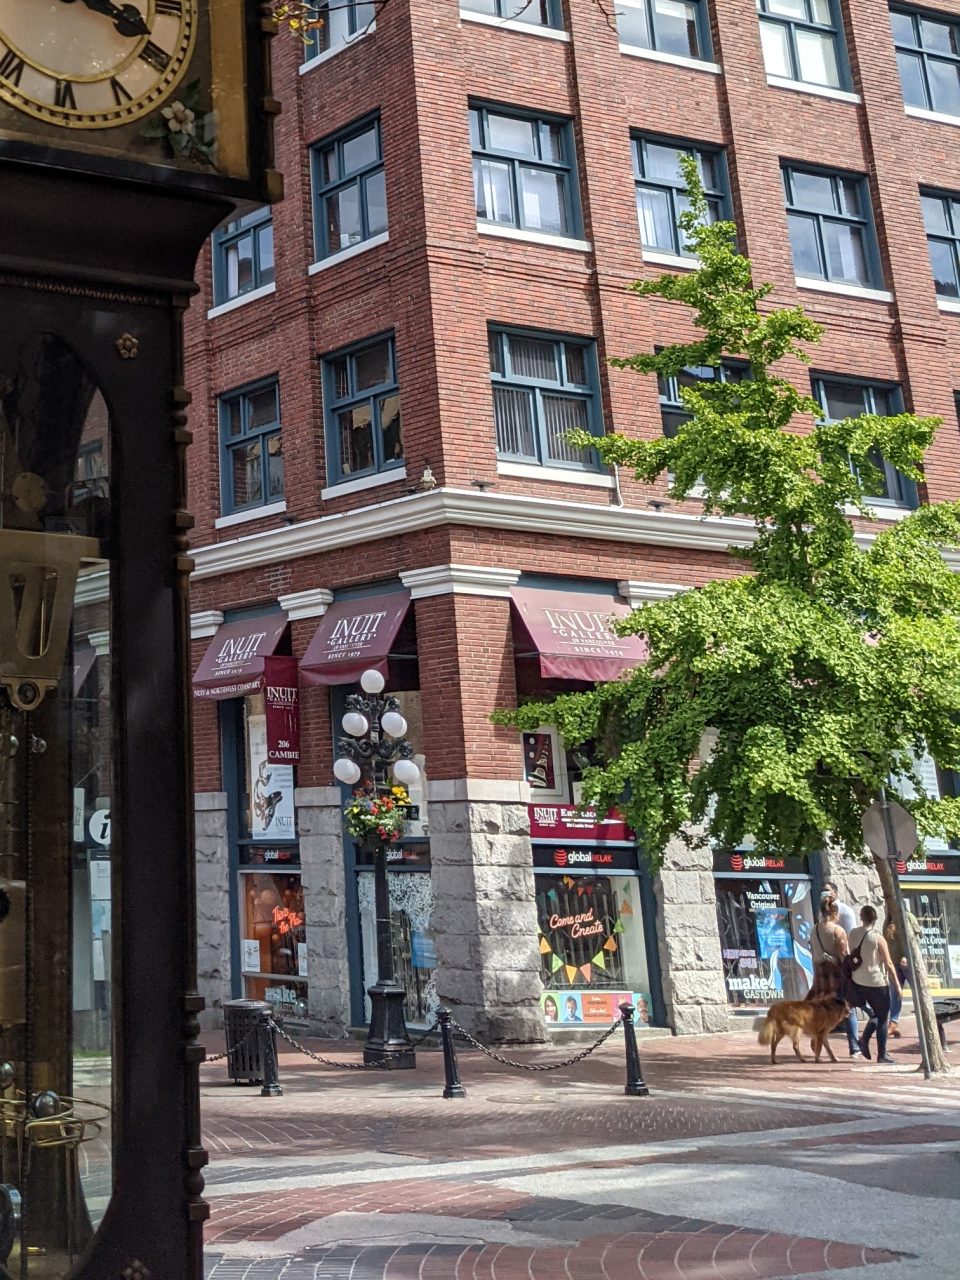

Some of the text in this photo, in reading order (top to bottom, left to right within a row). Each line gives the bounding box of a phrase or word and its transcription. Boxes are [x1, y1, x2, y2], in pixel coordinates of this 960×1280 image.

[330, 611, 387, 639] INUIT
[217, 631, 267, 657] INUIT
[574, 646, 602, 654] SINCE
[267, 686, 298, 699] INUIT
[278, 739, 290, 749] 206
[269, 750, 300, 760] CAMBIE
[534, 807, 558, 818] INUIT
[568, 851, 592, 864] global
[743, 857, 766, 869] global
[907, 860, 927, 872] global
[746, 892, 780, 900] Vancouver
[750, 901, 777, 910] Original
[550, 907, 593, 928] Come and
[571, 920, 603, 938] Create
[728, 974, 768, 990] make
[743, 989, 784, 999] GASTOWN
